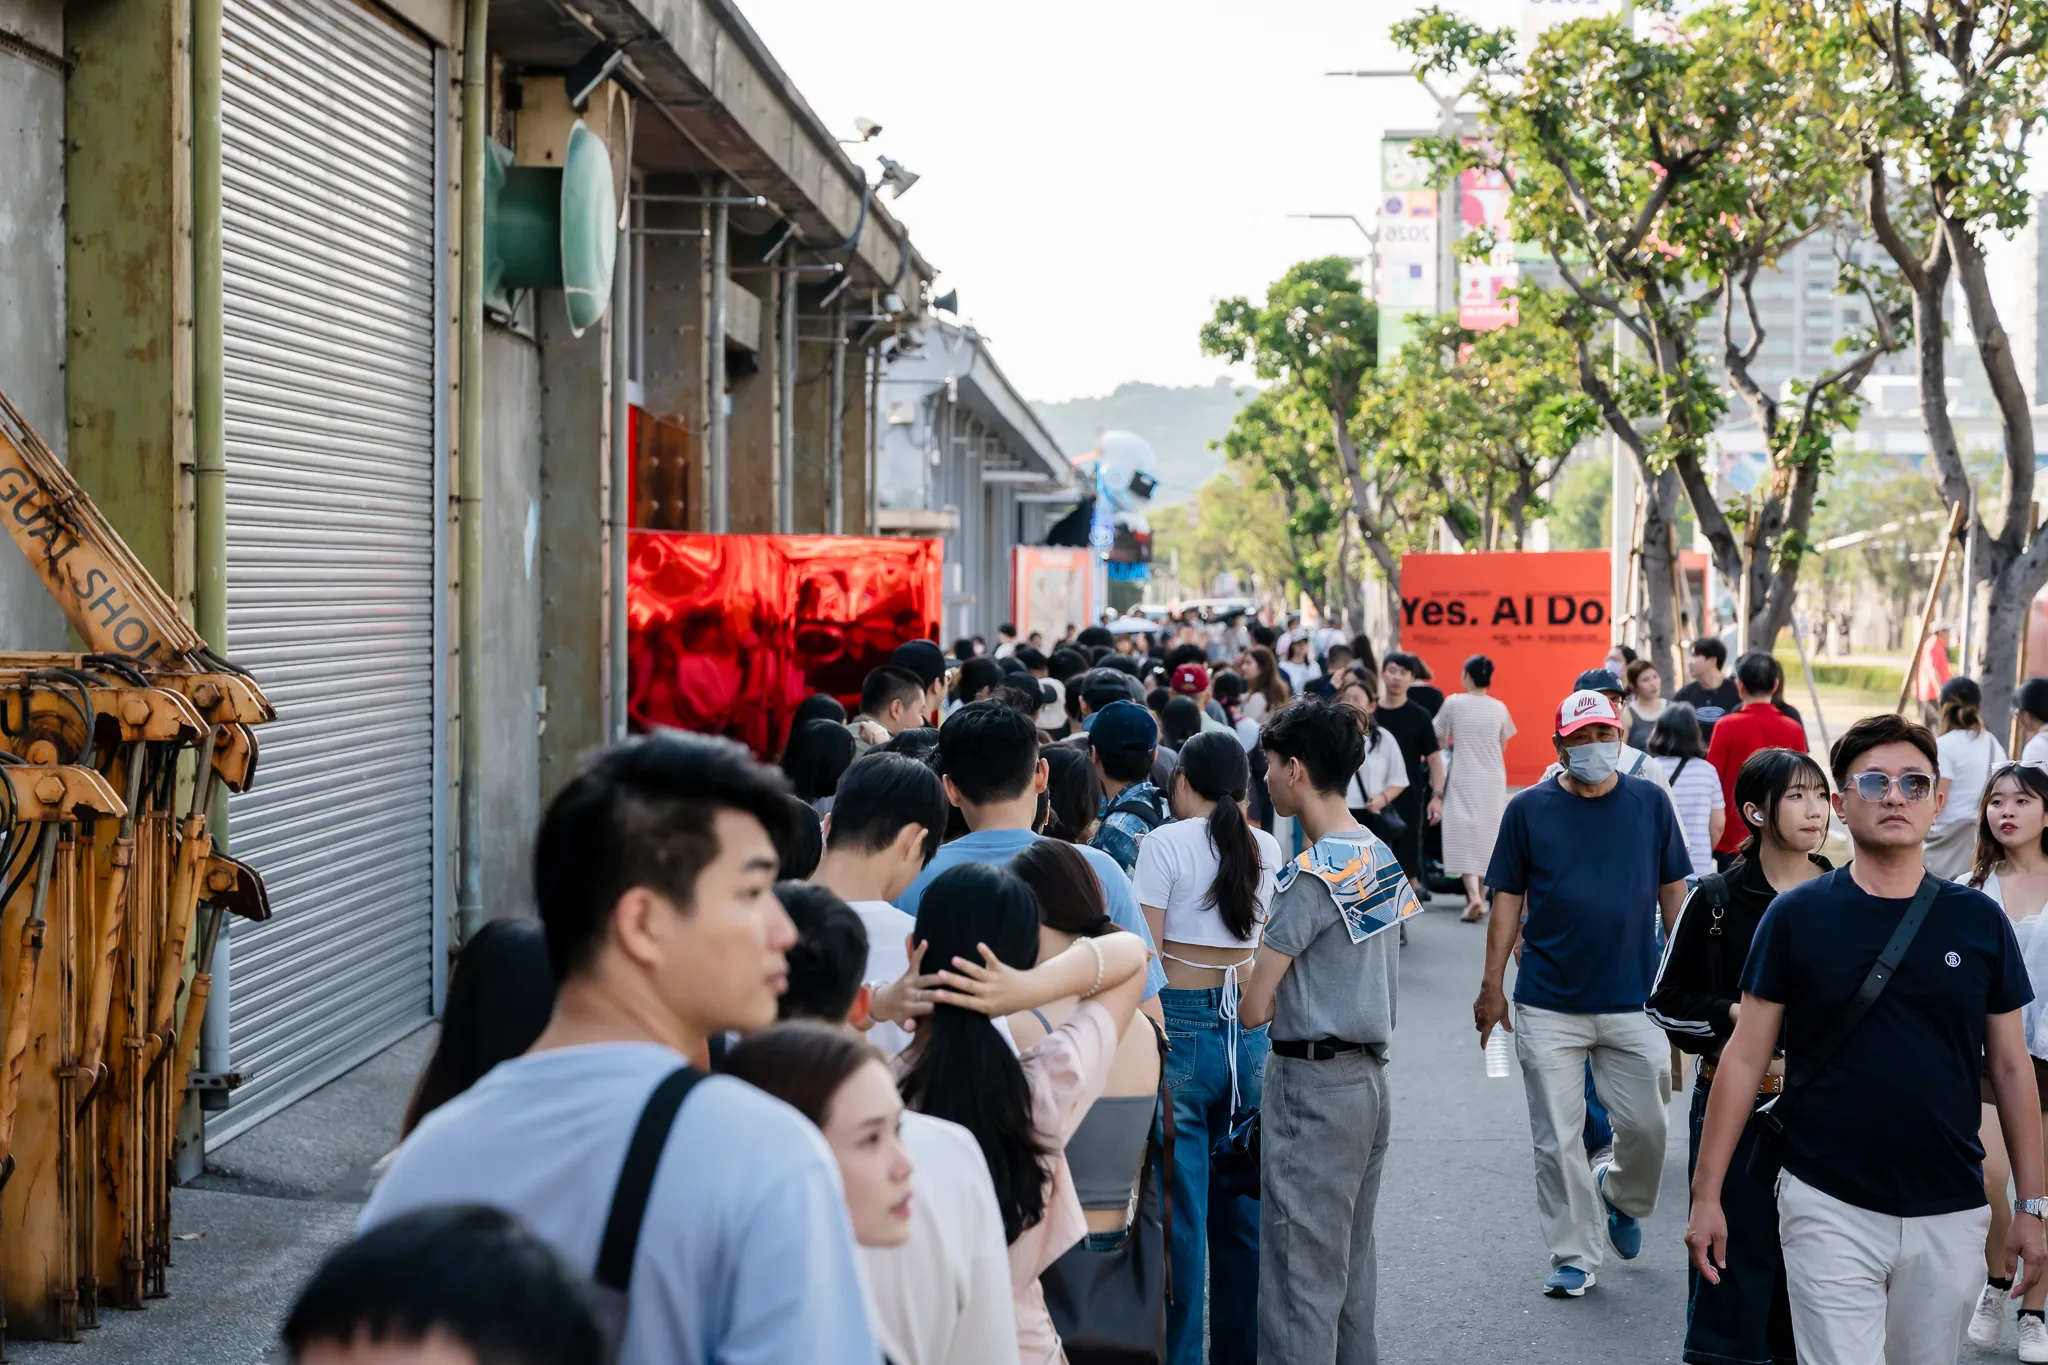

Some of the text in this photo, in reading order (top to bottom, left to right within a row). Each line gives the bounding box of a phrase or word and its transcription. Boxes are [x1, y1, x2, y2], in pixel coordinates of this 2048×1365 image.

[1401, 596, 1479, 626] Yes.
[1491, 596, 1534, 626] AI
[1577, 696, 1597, 708] NIKE
